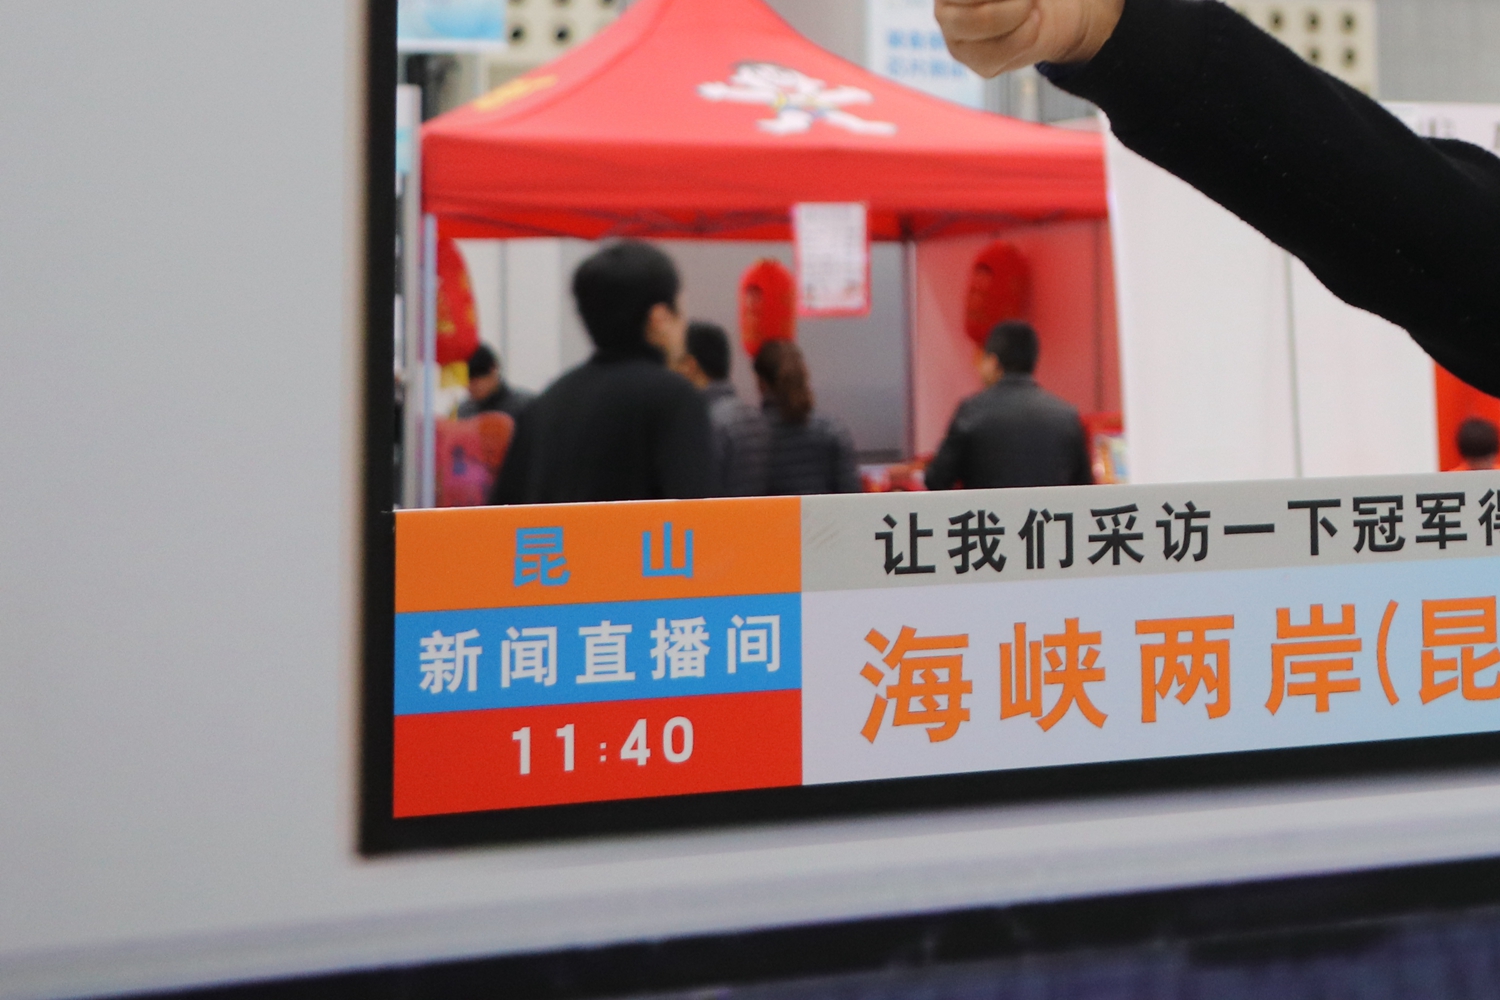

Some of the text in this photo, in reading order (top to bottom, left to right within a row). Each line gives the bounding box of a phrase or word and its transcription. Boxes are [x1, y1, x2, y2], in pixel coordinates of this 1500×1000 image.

[511, 521, 695, 587] 昆山
[418, 614, 782, 695] 新闻直播间
[511, 715, 695, 776] 11:40
